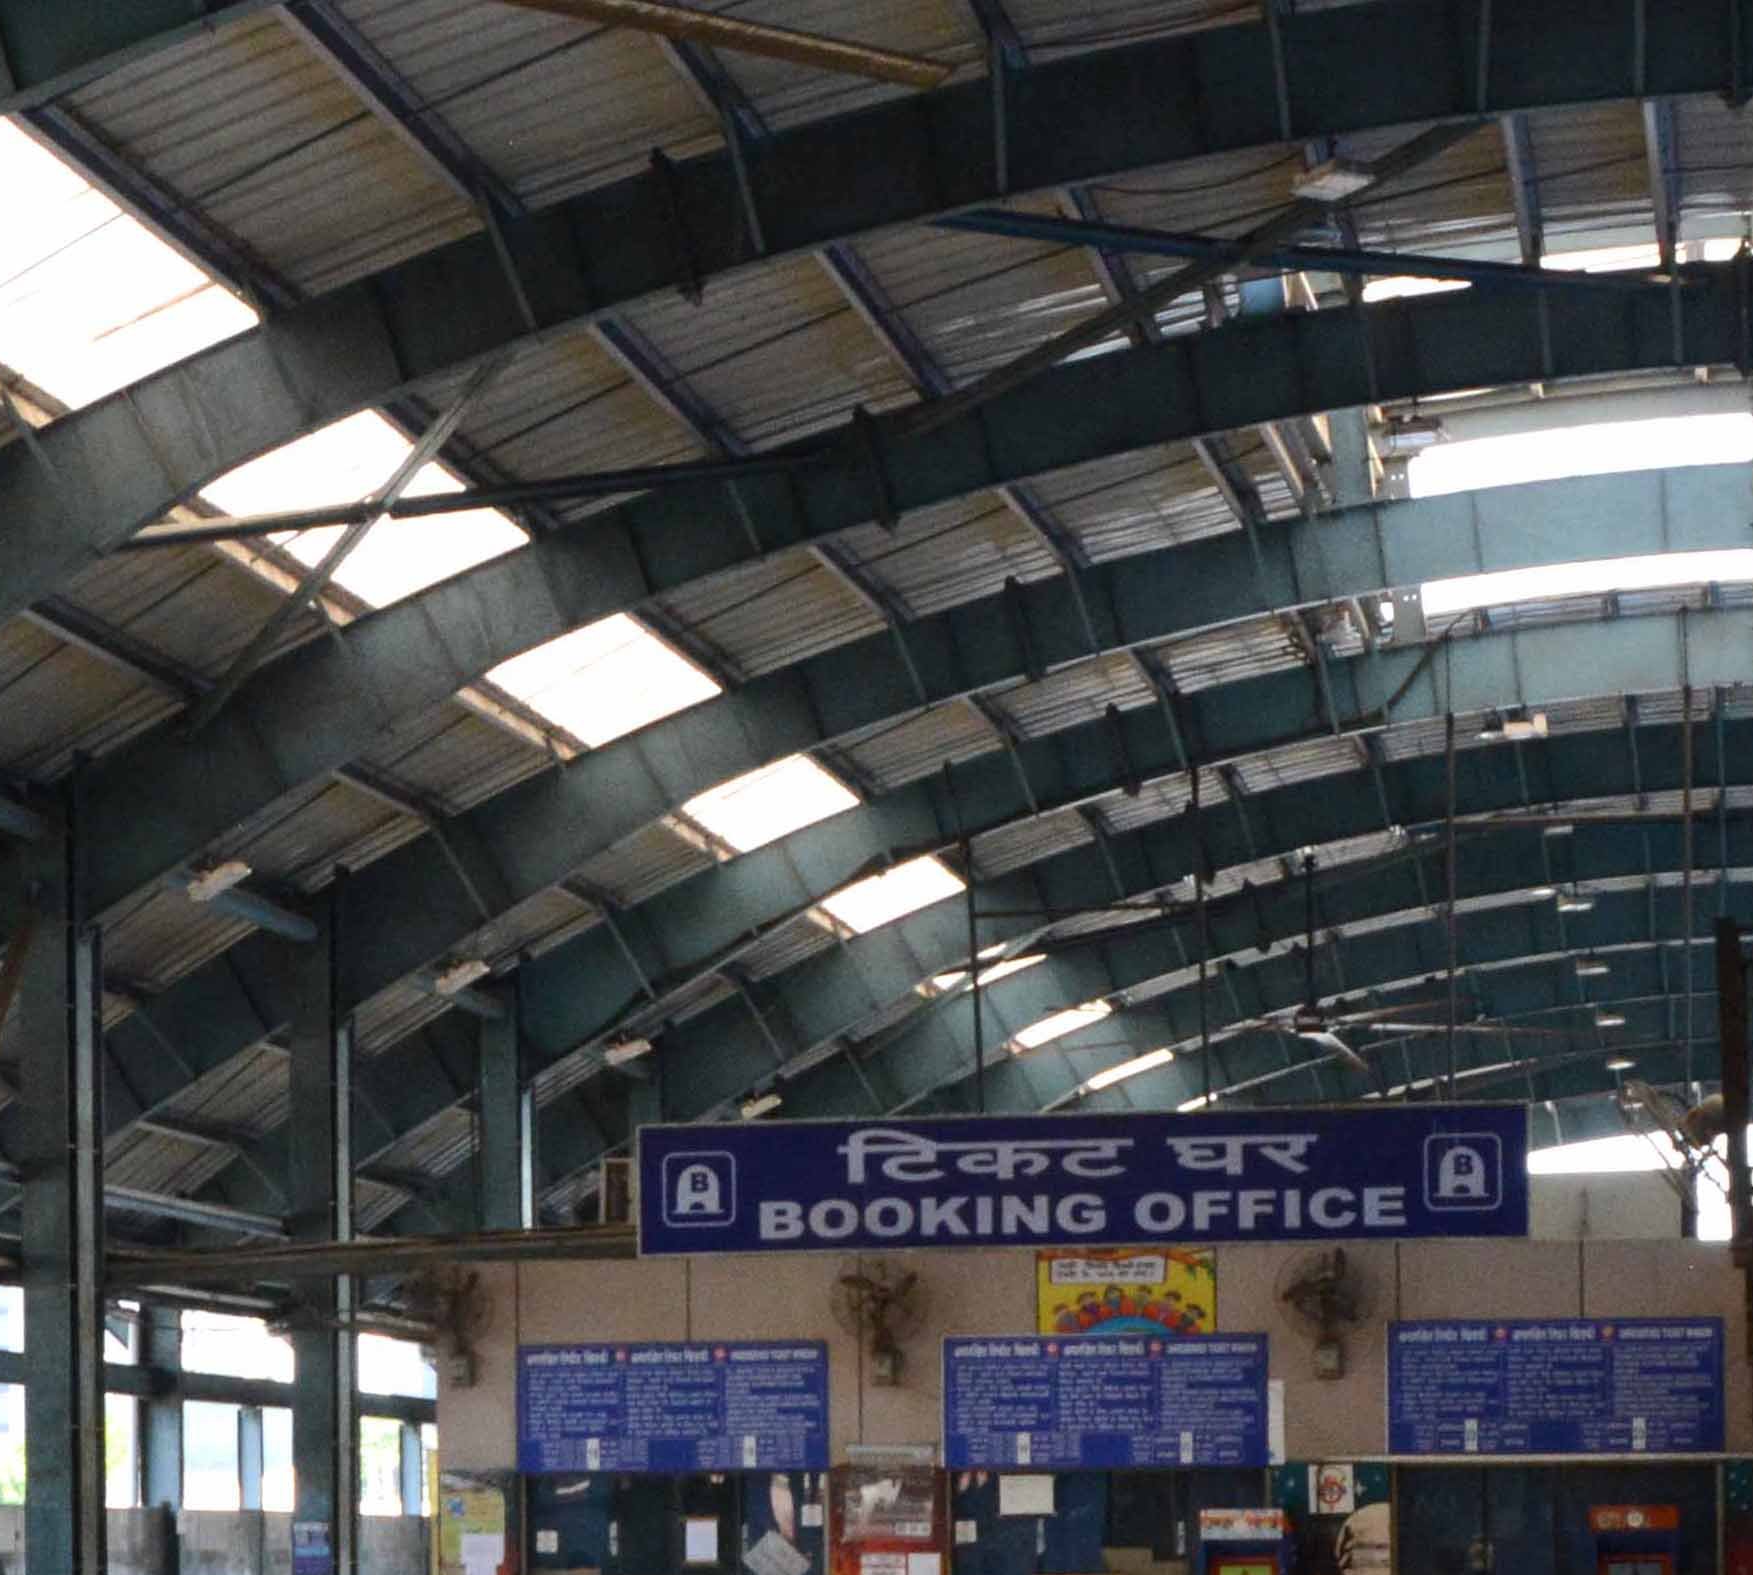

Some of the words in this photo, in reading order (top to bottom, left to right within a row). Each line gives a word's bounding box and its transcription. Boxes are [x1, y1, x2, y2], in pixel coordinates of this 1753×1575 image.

[836, 1127, 1135, 1185] टिकट
[1165, 1133, 1319, 1175] घर
[1453, 1152, 1472, 1175] B
[691, 1170, 710, 1194] B
[758, 1192, 1108, 1241] BOOKING
[1133, 1186, 1408, 1234] OFFICE
